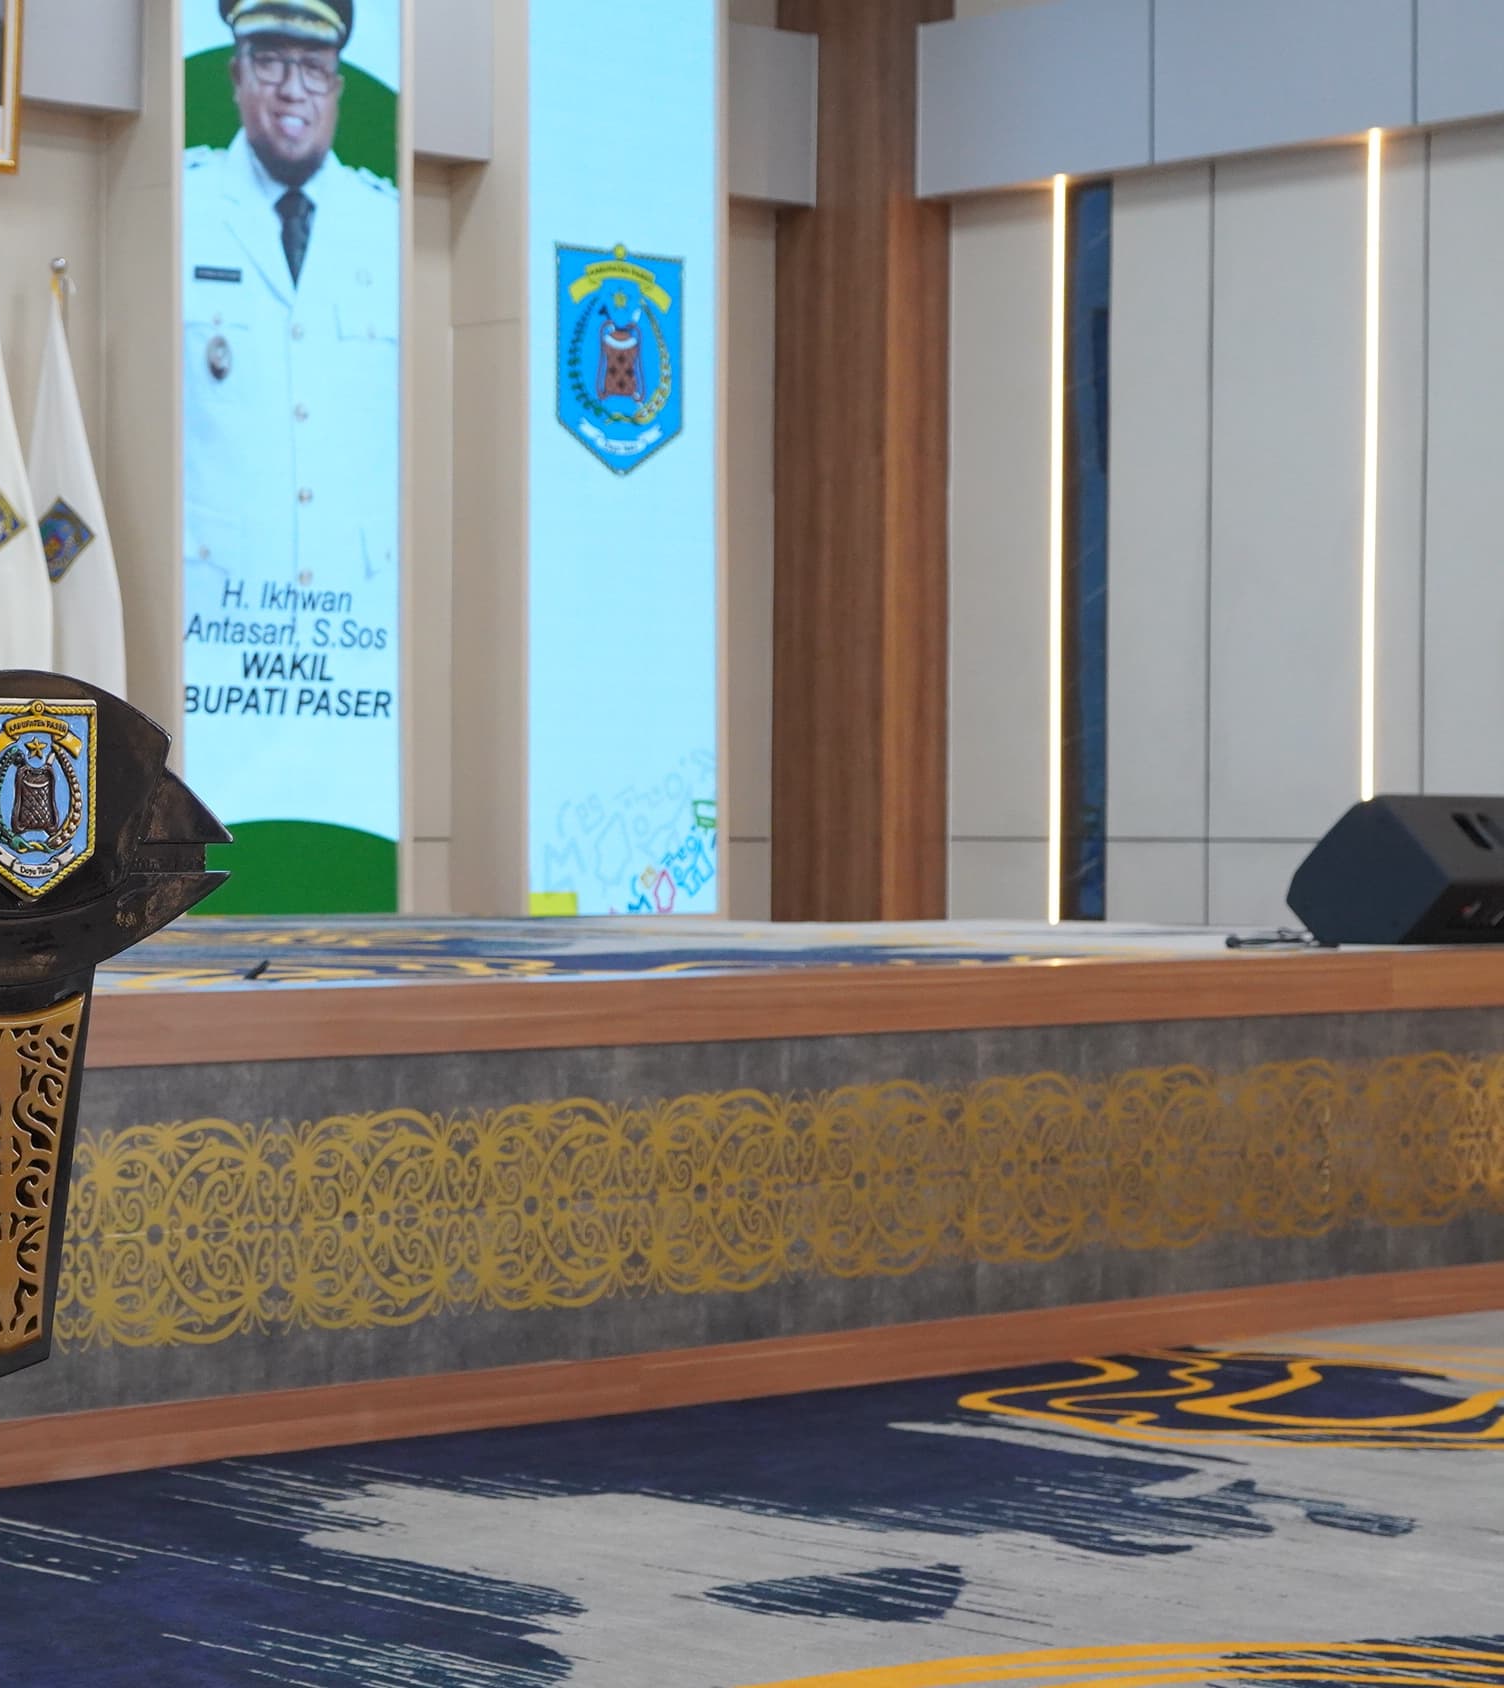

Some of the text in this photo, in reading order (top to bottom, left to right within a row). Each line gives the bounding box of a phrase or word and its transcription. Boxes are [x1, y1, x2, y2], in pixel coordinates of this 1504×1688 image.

[221, 578, 353, 613] H. Ikhwan
[184, 613, 388, 649] Antasari, S.Sos
[242, 651, 334, 681] WAKIL
[184, 685, 392, 718] BUPATI PASER
